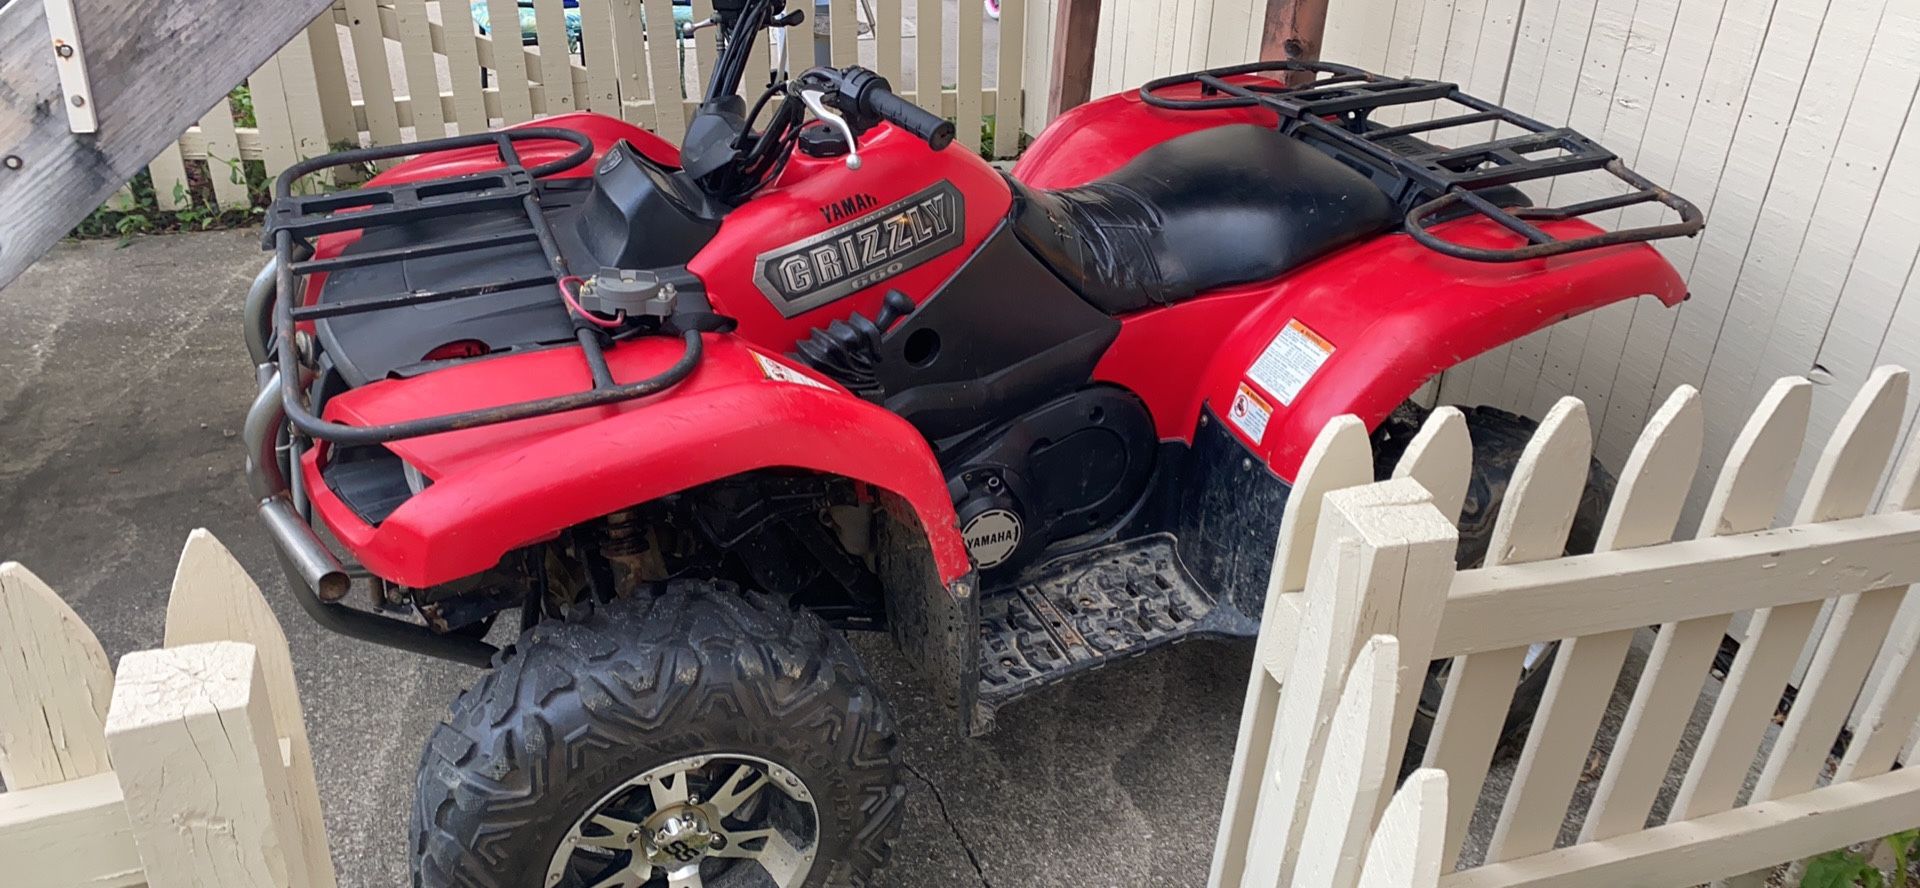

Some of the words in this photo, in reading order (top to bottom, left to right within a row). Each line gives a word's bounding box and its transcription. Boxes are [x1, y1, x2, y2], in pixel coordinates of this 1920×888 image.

[779, 193, 948, 292] GRIZZLY
[851, 262, 903, 289] 660
[967, 530, 1012, 549] YAMAHA
